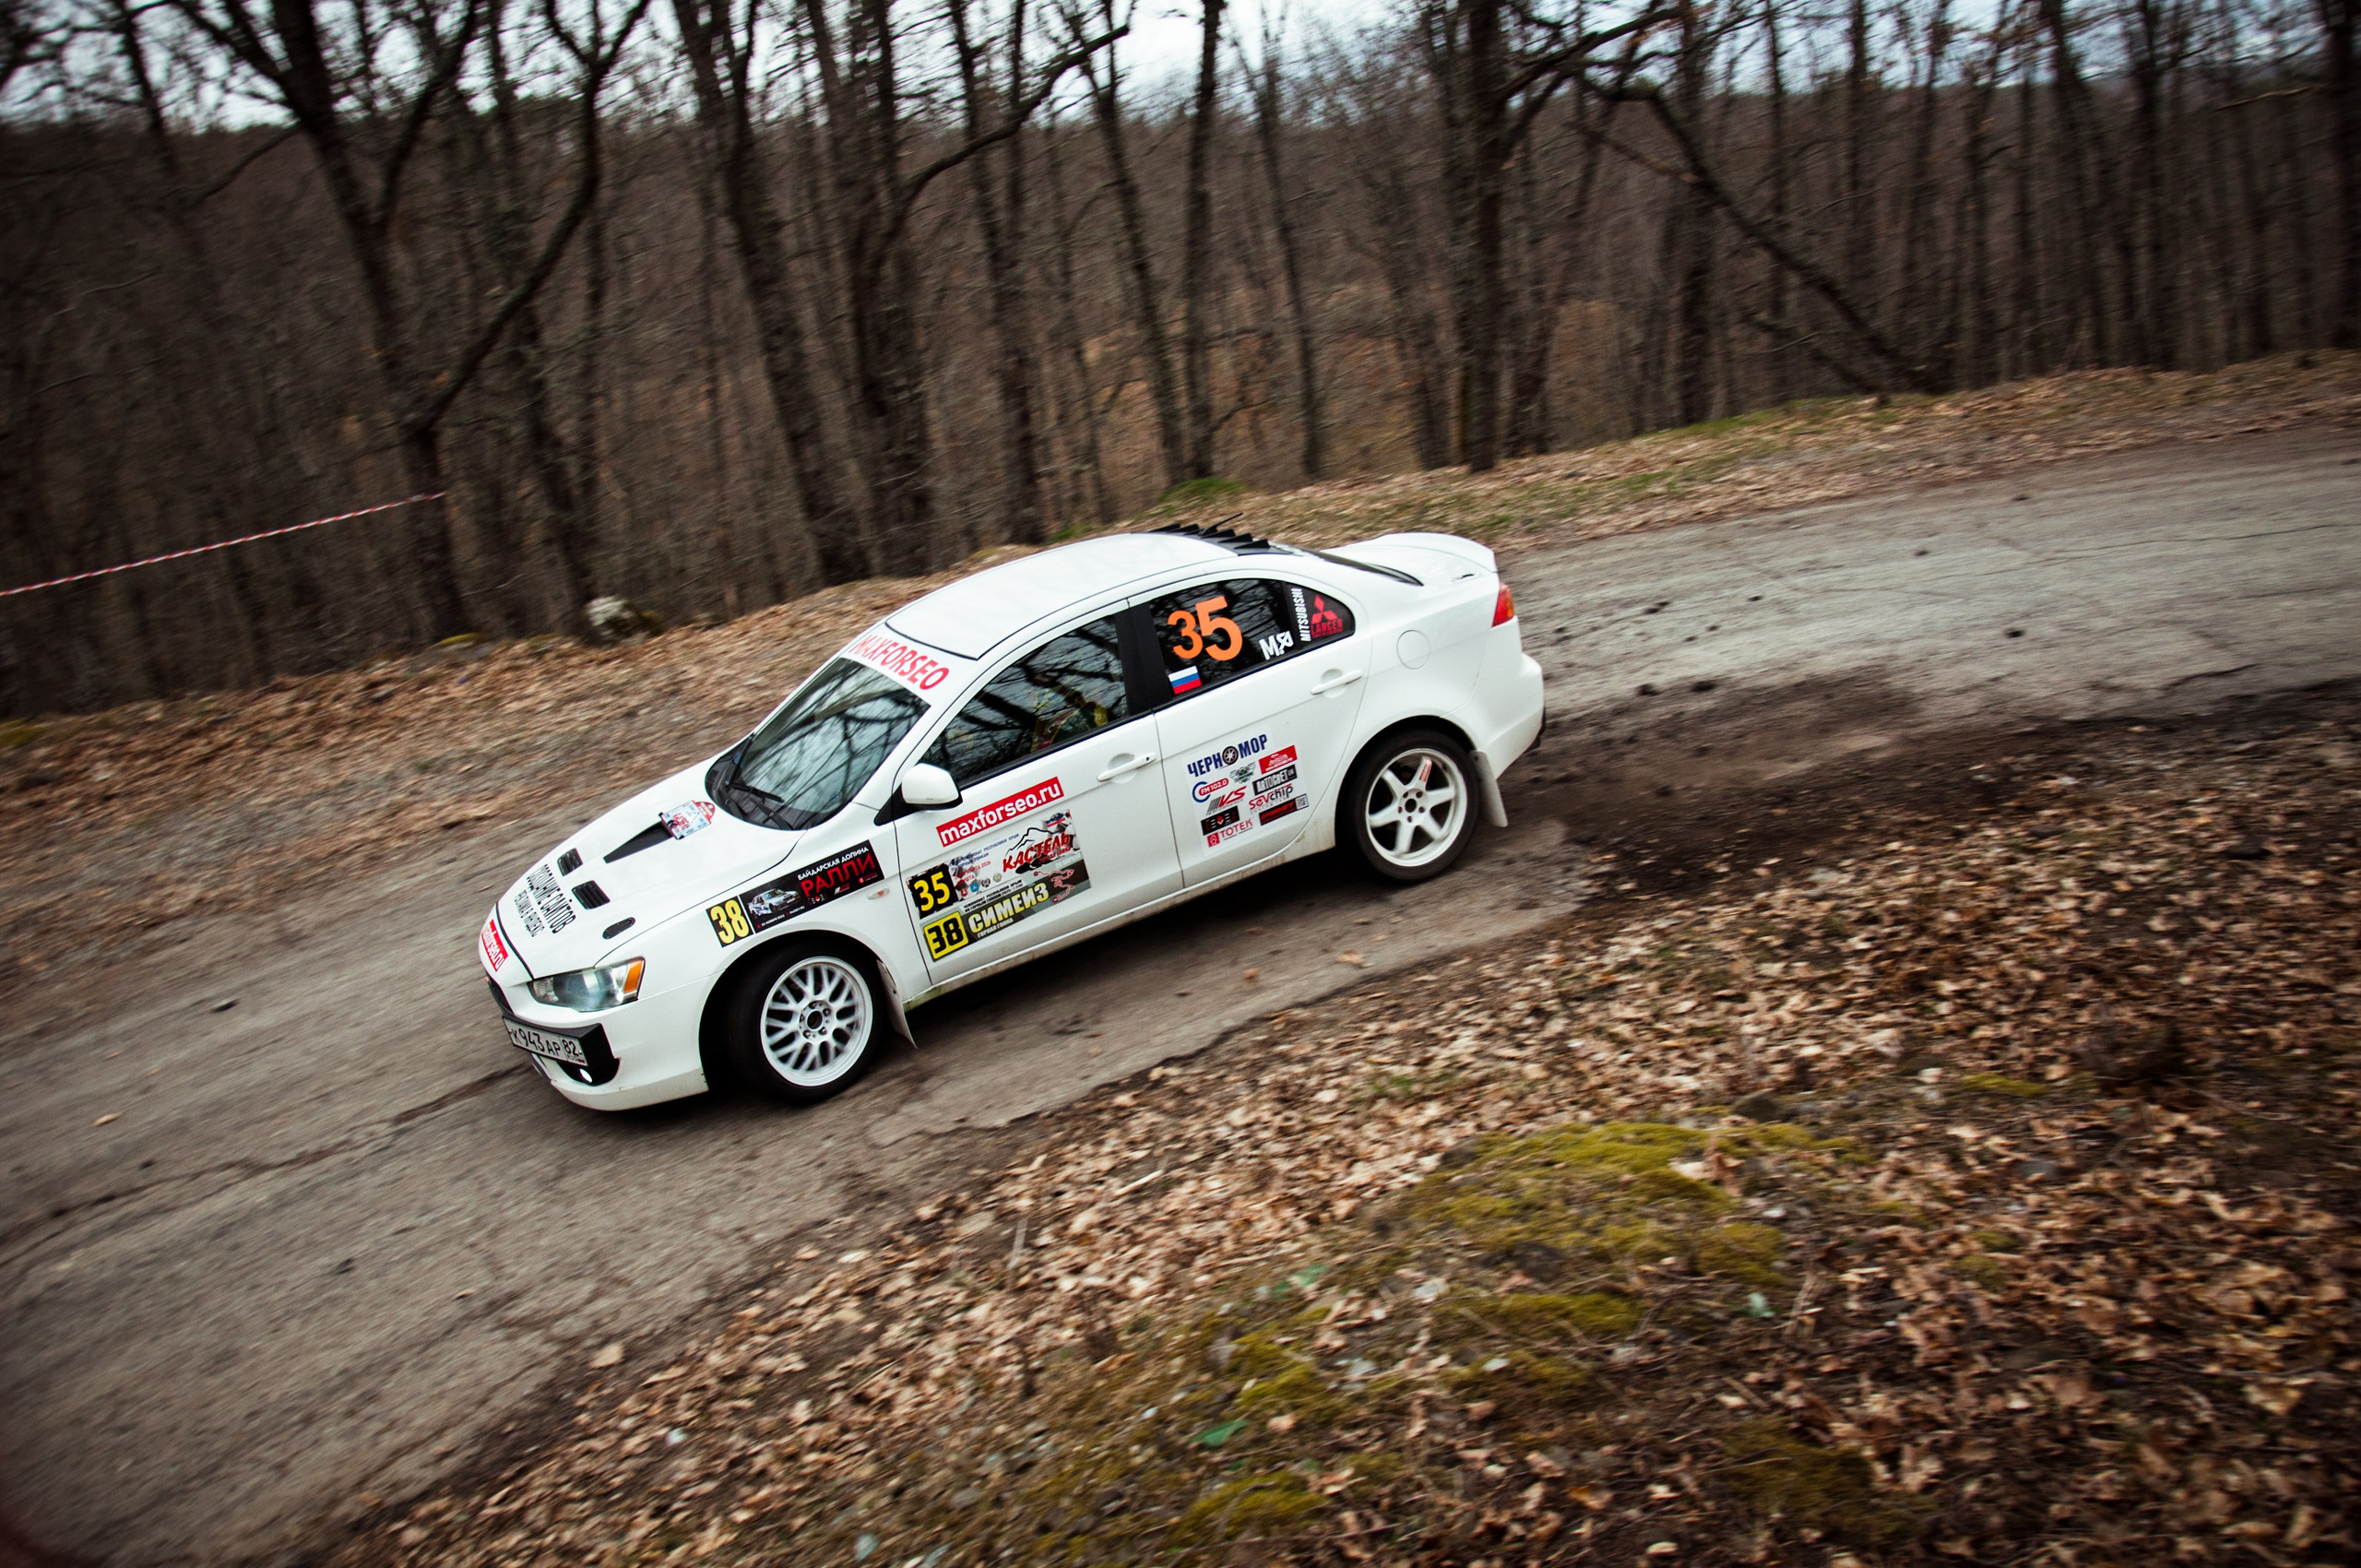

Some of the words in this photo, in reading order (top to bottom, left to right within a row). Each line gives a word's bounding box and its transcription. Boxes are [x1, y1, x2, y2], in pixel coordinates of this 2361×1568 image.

[1168, 596, 1242, 661] 35
[1291, 588, 1311, 642] MITSUBISHI
[848, 635, 949, 690] MAXFORSEO
[1201, 786, 1211, 795] FM
[1210, 779, 1228, 792] 102.0
[1218, 786, 1247, 808] VS
[941, 782, 1061, 845] maxforseo.ru
[797, 858, 840, 881] БАЙДАРСКАЯ
[841, 847, 869, 863] ДОЛИНА
[1003, 832, 1070, 873] КАСТЕЛЬ
[801, 852, 875, 897] РАЛЛИ
[914, 872, 951, 912] 35
[540, 893, 576, 933] САЙТОВ
[710, 899, 750, 944] 38
[968, 883, 1050, 933] СИМЕИЗ
[928, 918, 965, 954] 38
[562, 1039, 579, 1056] 82
